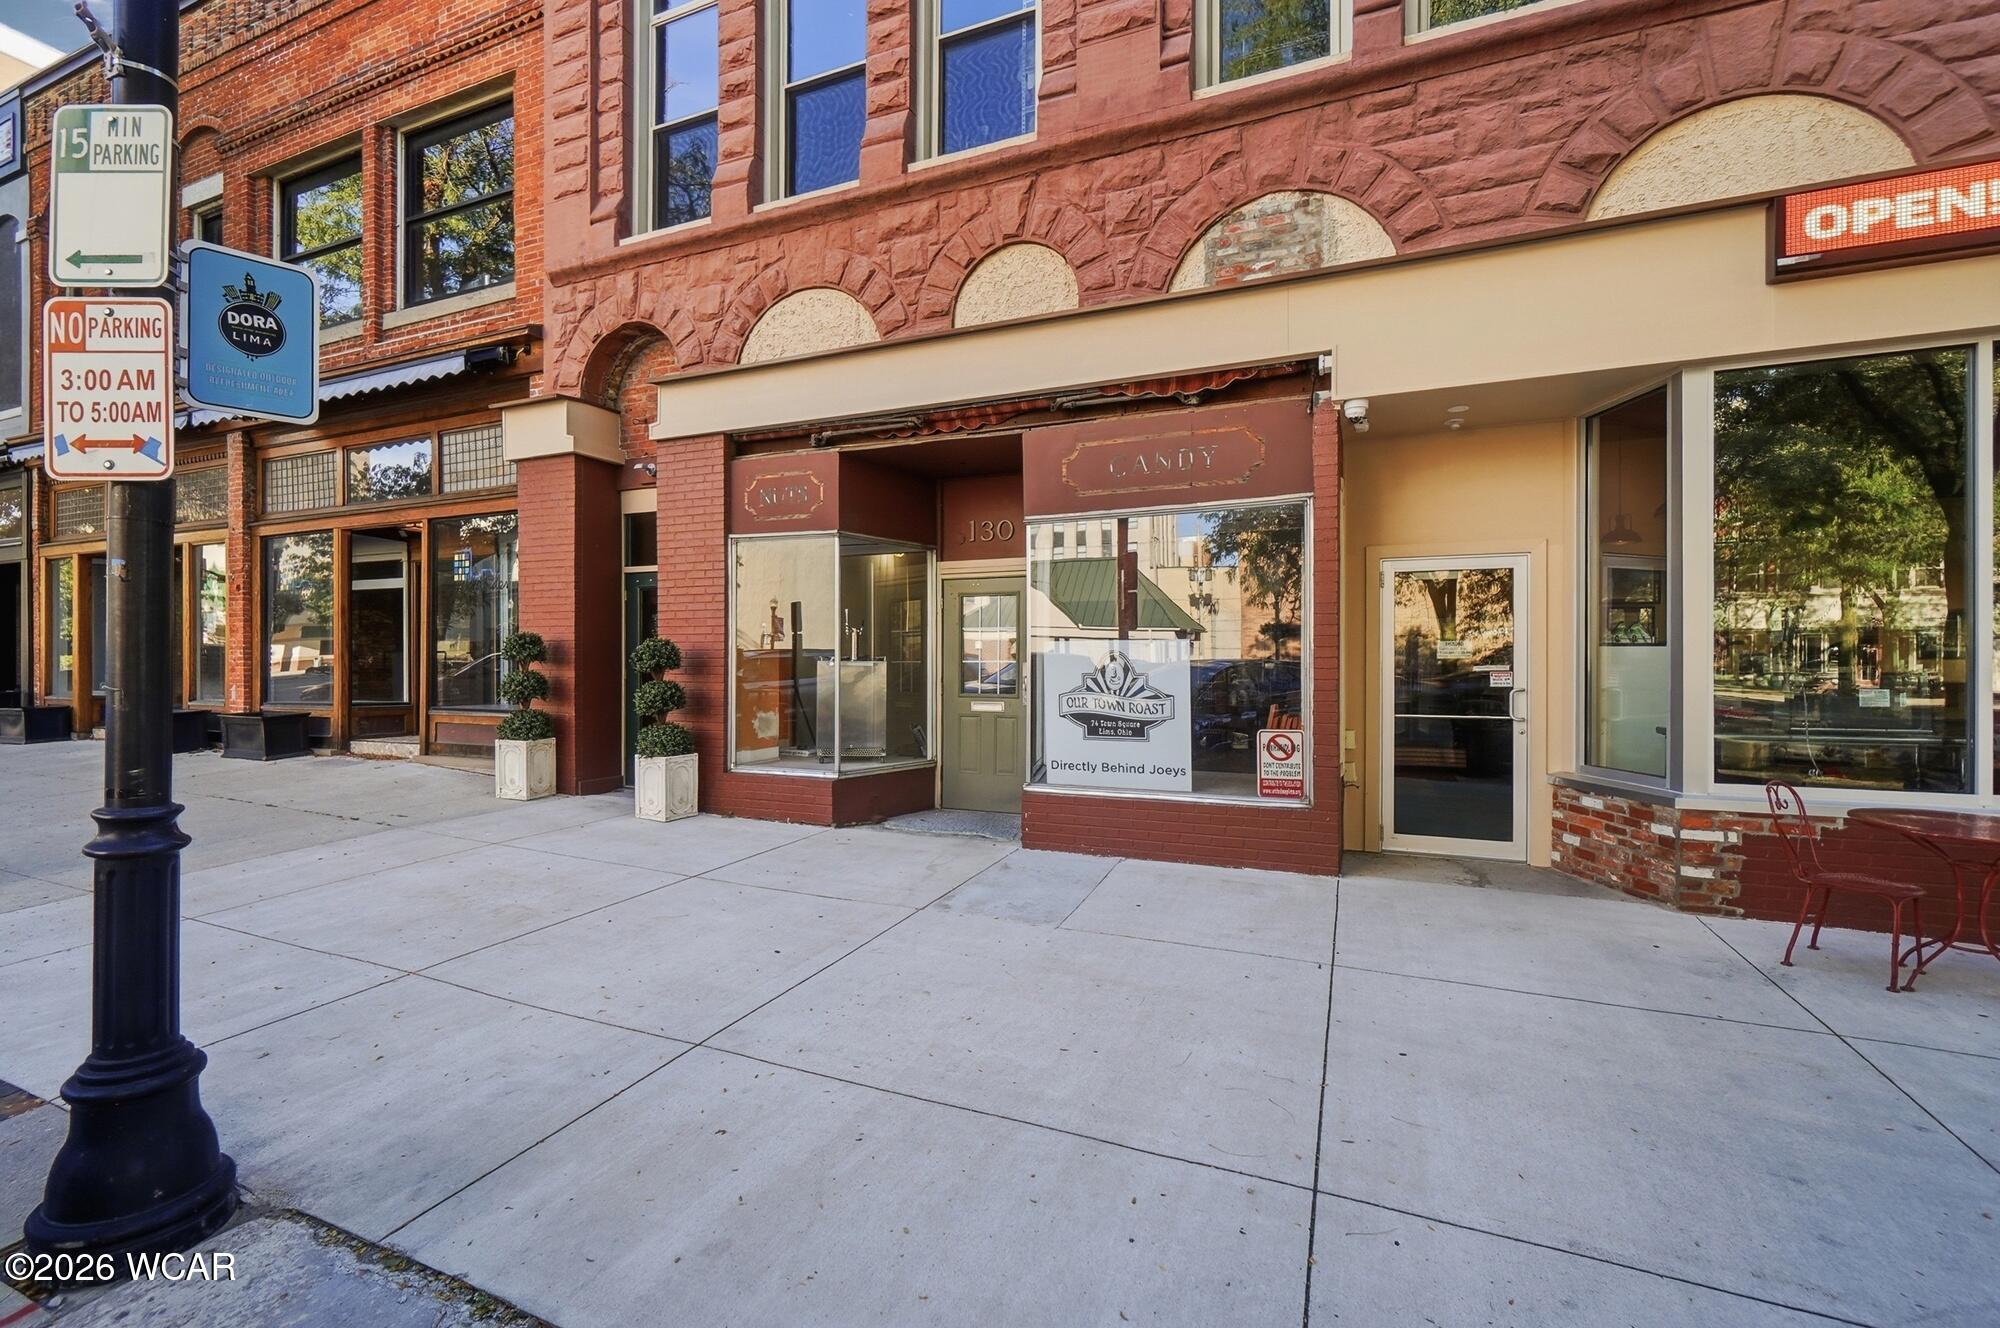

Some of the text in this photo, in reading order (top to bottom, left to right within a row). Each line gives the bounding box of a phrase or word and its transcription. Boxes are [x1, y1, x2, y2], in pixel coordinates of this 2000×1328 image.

[107, 116, 142, 137] MIN
[60, 127, 88, 159] 15
[93, 143, 159, 165] PARKING
[50, 311, 162, 344] NO PARKING
[227, 311, 278, 330] DORA
[233, 331, 271, 347] LIMA
[61, 369, 155, 391] 3:00 AM
[57, 401, 161, 422] TO 5:00AM
[1109, 445, 1219, 478] CANDY
[969, 519, 1015, 542] 130
[1066, 696, 1166, 715] OUR TOWN ROAST
[1100, 720, 1117, 728] Town
[1117, 720, 1141, 728] Square
[1117, 728, 1133, 736] Ohio
[1051, 760, 1187, 778] Directly Behind Joeys
